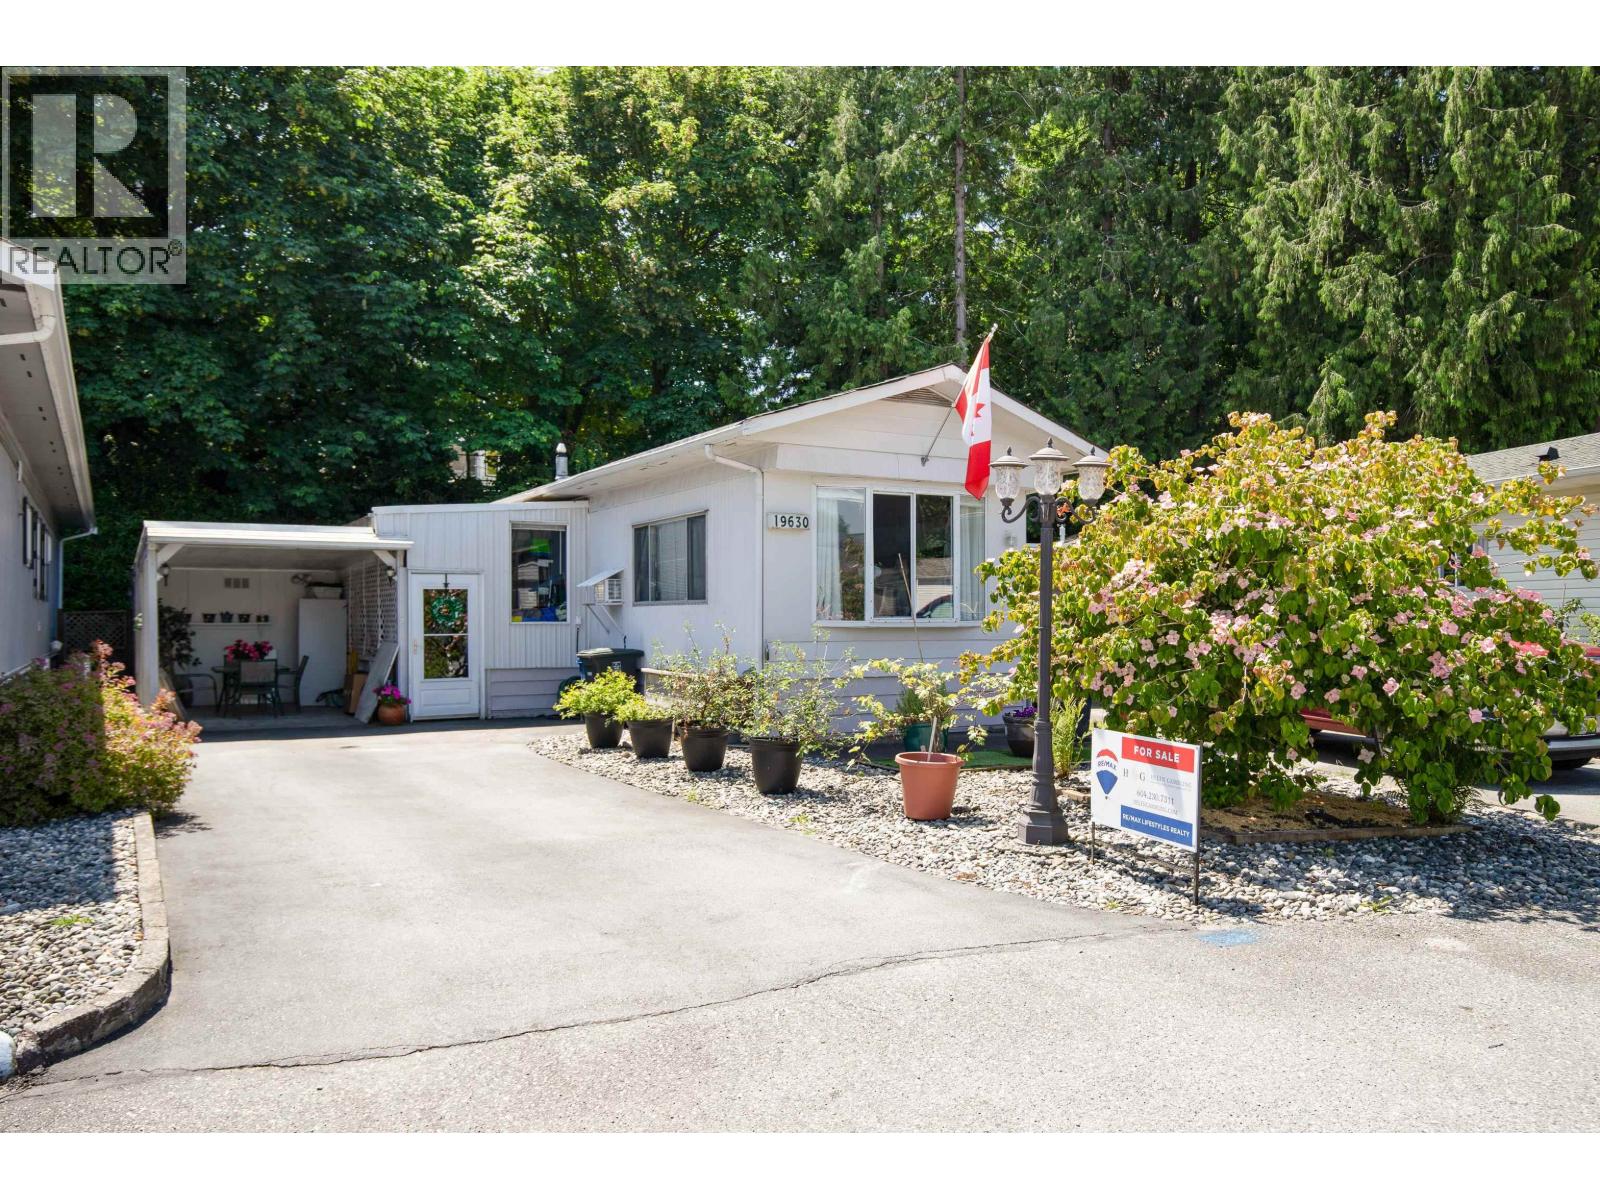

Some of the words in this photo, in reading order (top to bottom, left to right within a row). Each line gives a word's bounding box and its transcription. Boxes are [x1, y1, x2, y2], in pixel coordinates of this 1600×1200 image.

[774, 514, 809, 529] 19630
[1133, 745, 1152, 758] FOR
[1155, 750, 1180, 763] SALE
[1122, 813, 1141, 824] RE/MAX
[1141, 818, 1170, 832] LIFESTYLES
[1170, 826, 1190, 838] REALTY
